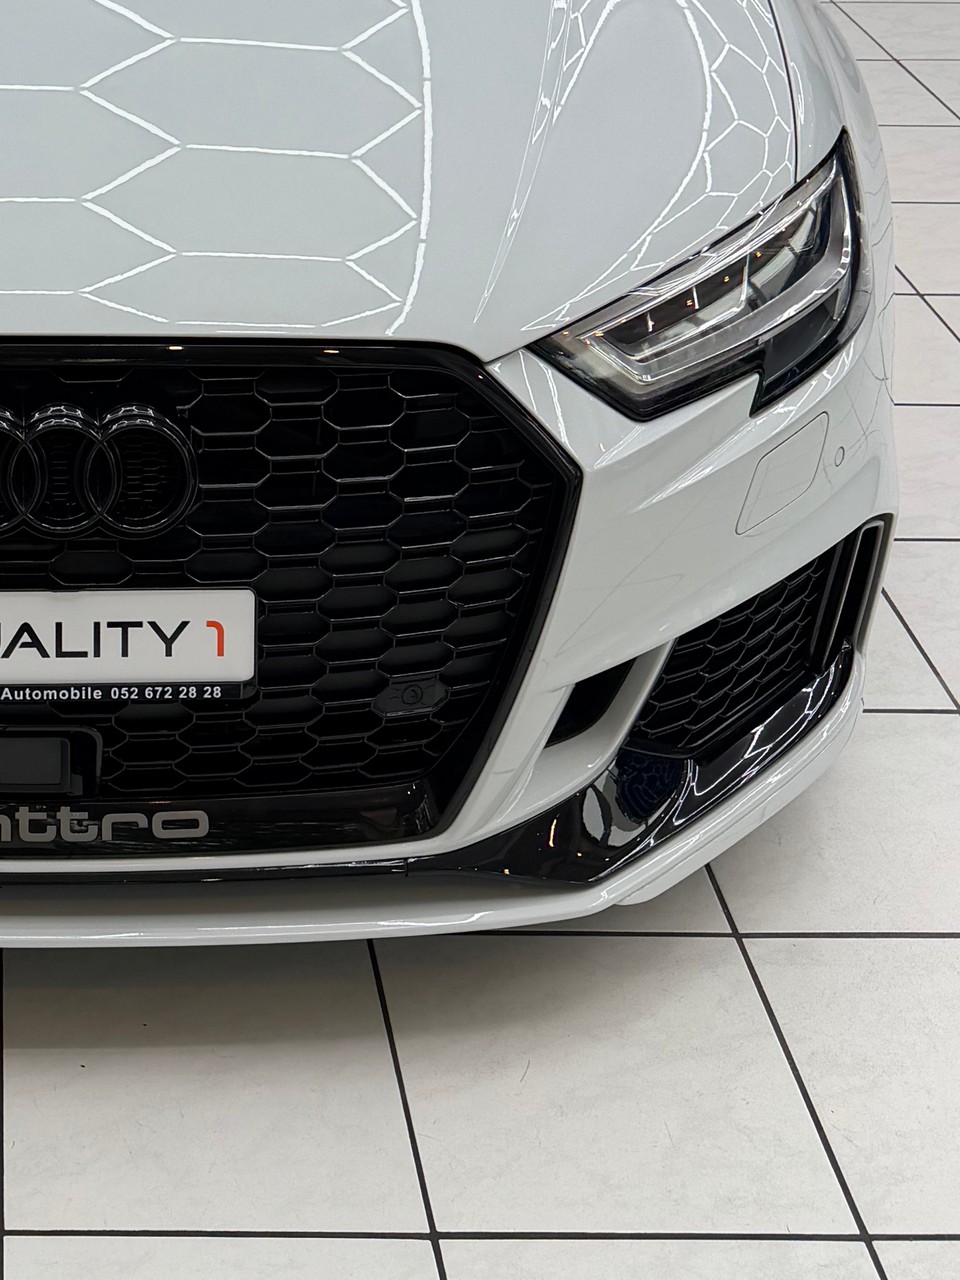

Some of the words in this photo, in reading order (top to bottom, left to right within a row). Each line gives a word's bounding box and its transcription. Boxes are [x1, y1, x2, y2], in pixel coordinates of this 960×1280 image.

[205, 620, 225, 657] 1
[0, 687, 102, 701] Automobile
[110, 686, 139, 700] 052
[144, 686, 173, 699] 672
[178, 686, 197, 699] 28
[203, 686, 222, 699] 28
